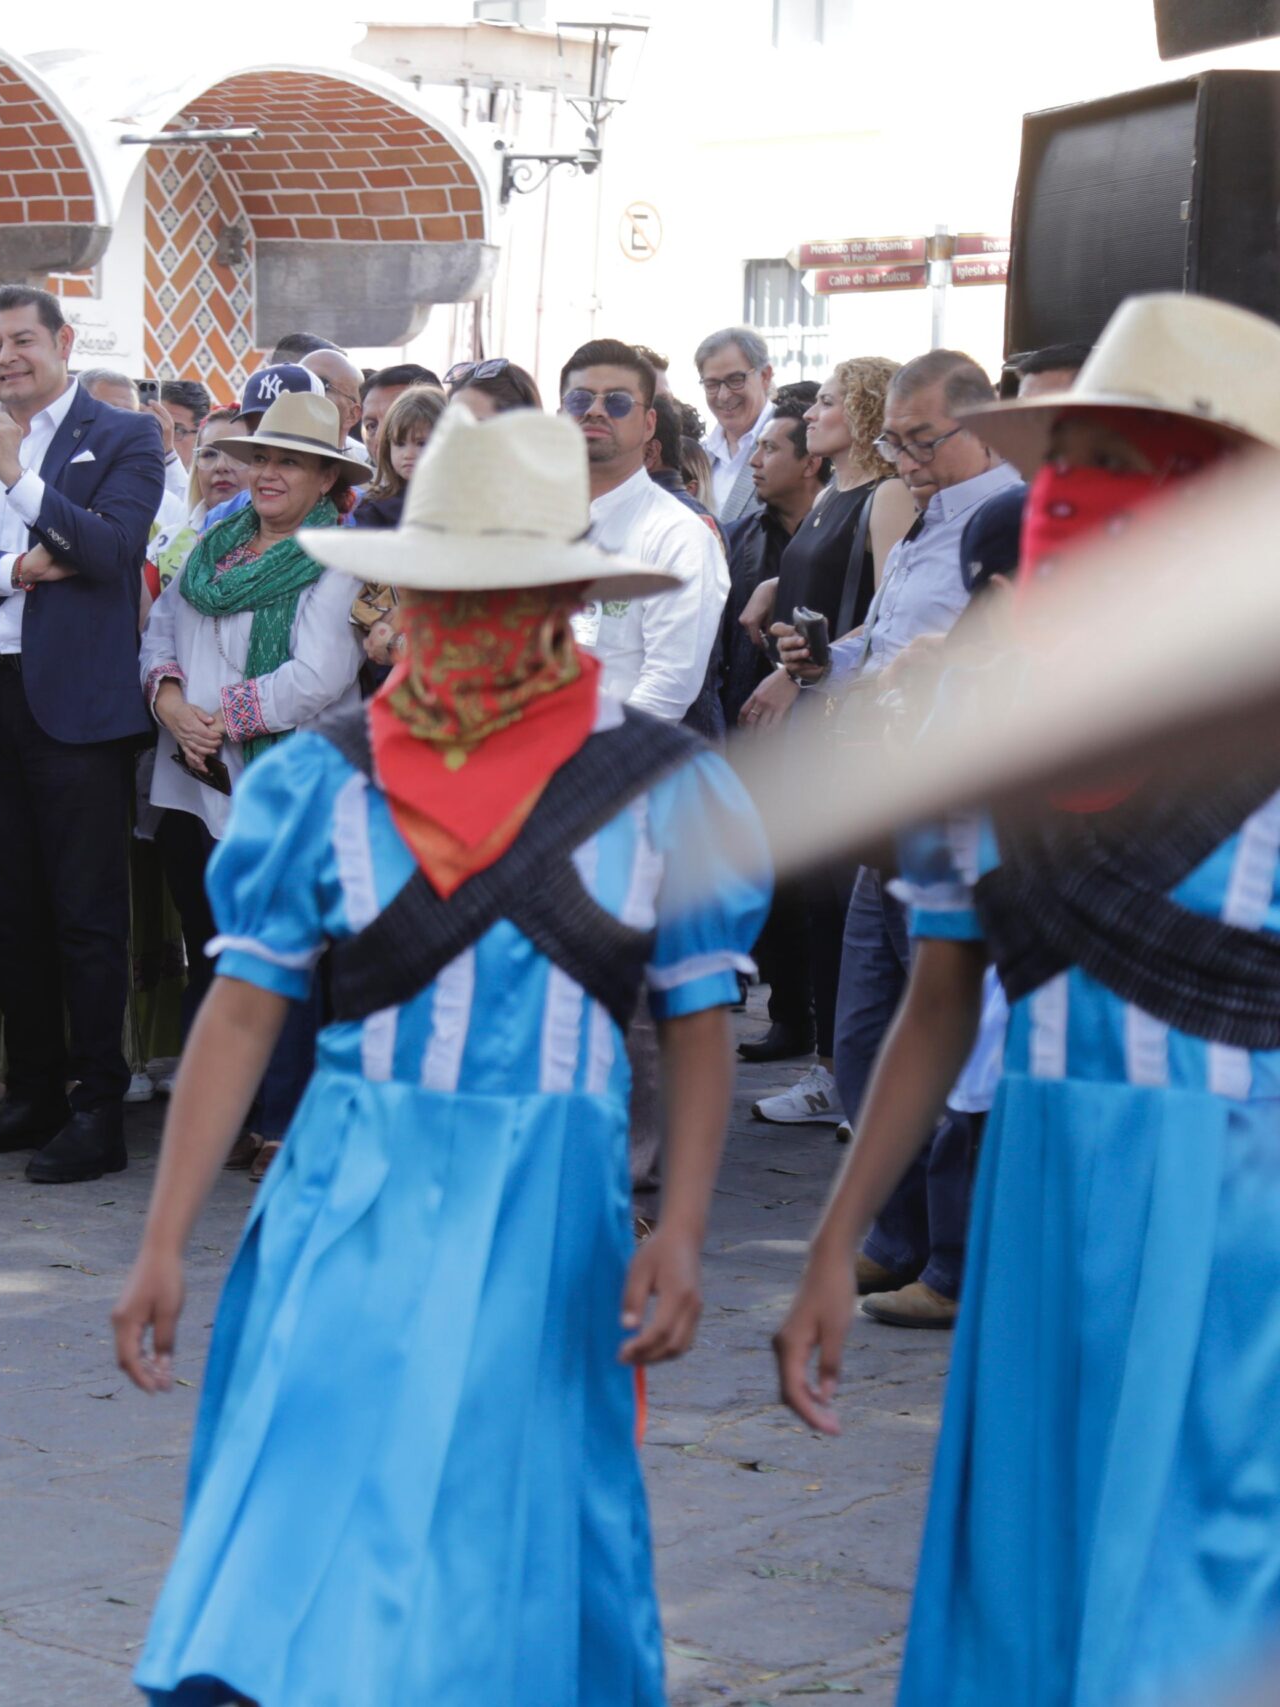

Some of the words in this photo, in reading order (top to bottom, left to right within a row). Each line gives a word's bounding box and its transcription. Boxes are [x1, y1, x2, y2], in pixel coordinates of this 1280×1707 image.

[810, 243, 849, 255] Mercado
[851, 242, 863, 252] de
[828, 274, 851, 286] Calle
[852, 273, 864, 284] de
[866, 272, 880, 283] los
[882, 271, 911, 282] Dulces
[956, 265, 985, 280] Iglesia
[987, 263, 1000, 275] de
[257, 373, 283, 400] NY
